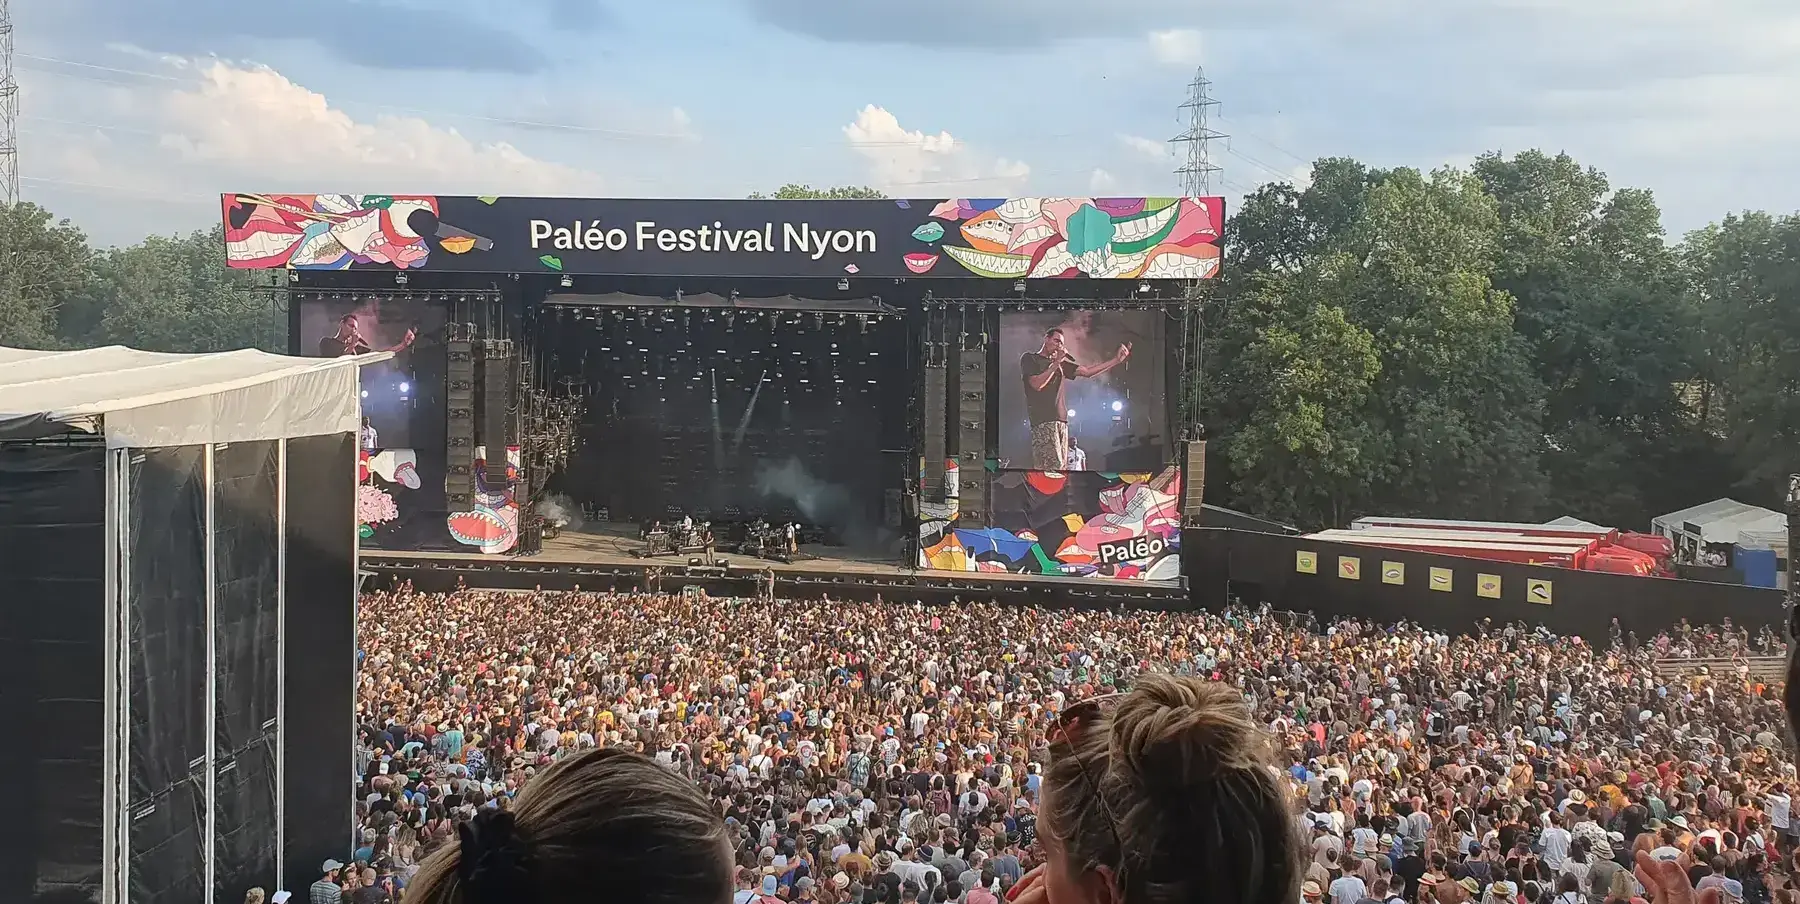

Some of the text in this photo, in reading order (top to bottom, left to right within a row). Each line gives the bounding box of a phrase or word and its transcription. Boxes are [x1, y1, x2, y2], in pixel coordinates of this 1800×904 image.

[530, 219, 876, 260] Paléo Festival Nyon
[1100, 537, 1163, 563] Paléo
